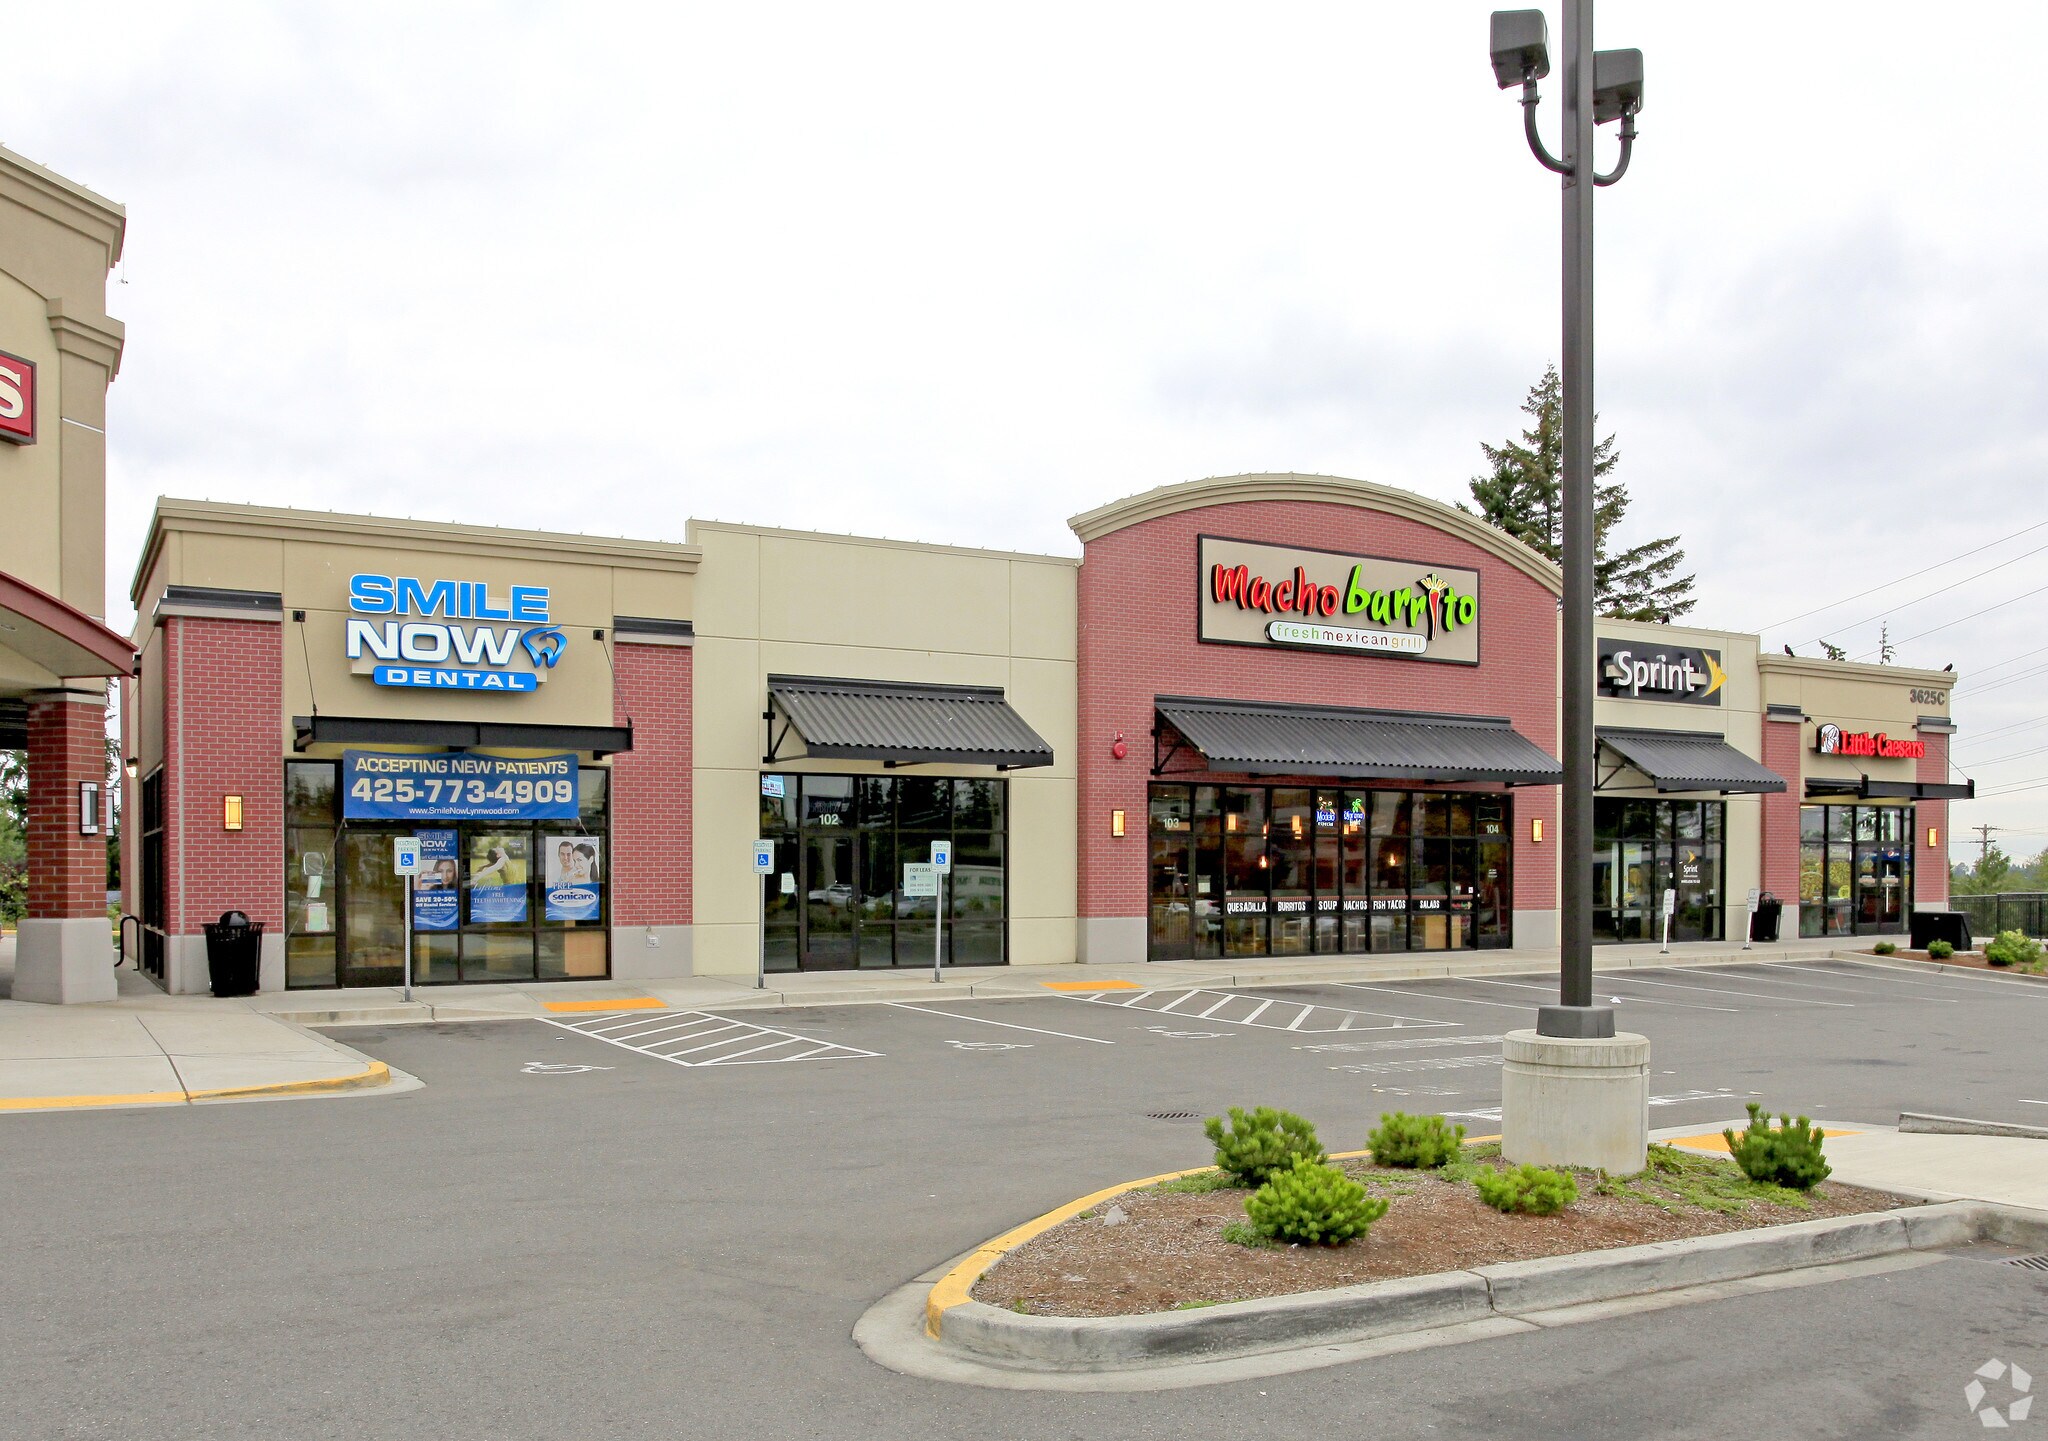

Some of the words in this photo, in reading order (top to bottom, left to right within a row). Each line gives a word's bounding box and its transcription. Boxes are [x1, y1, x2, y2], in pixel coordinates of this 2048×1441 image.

[349, 573, 550, 623] SMILE
[346, 618, 521, 666] NOW
[387, 669, 525, 689] DENTAL
[1613, 650, 1695, 697] Sprint
[1910, 688, 1945, 706] 3625C
[1840, 730, 1876, 756] Little
[1876, 732, 1925, 759] Caesars
[355, 757, 448, 774] ACCEPTING
[451, 759, 492, 774] NEW
[495, 760, 568, 775] PATIENTS
[351, 777, 573, 804] 425-773-4909
[408, 806, 520, 816] www.SmileNowLynnwood.com
[819, 813, 839, 825] 102
[1163, 818, 1179, 829] 103
[1486, 824, 1499, 834] 104
[417, 831, 453, 841] SMILE
[419, 840, 447, 848] NOW
[1683, 864, 1698, 874] Sprint
[552, 891, 594, 901] sonicare
[1227, 901, 1267, 914] QUESADILLA
[1277, 901, 1306, 912] BURRITOS
[1318, 900, 1338, 911] SOUP
[1343, 900, 1368, 910] NACHOS
[1373, 900, 1386, 910] FISH
[1387, 900, 1406, 910] TACOS
[1419, 900, 1440, 910] SALADS
